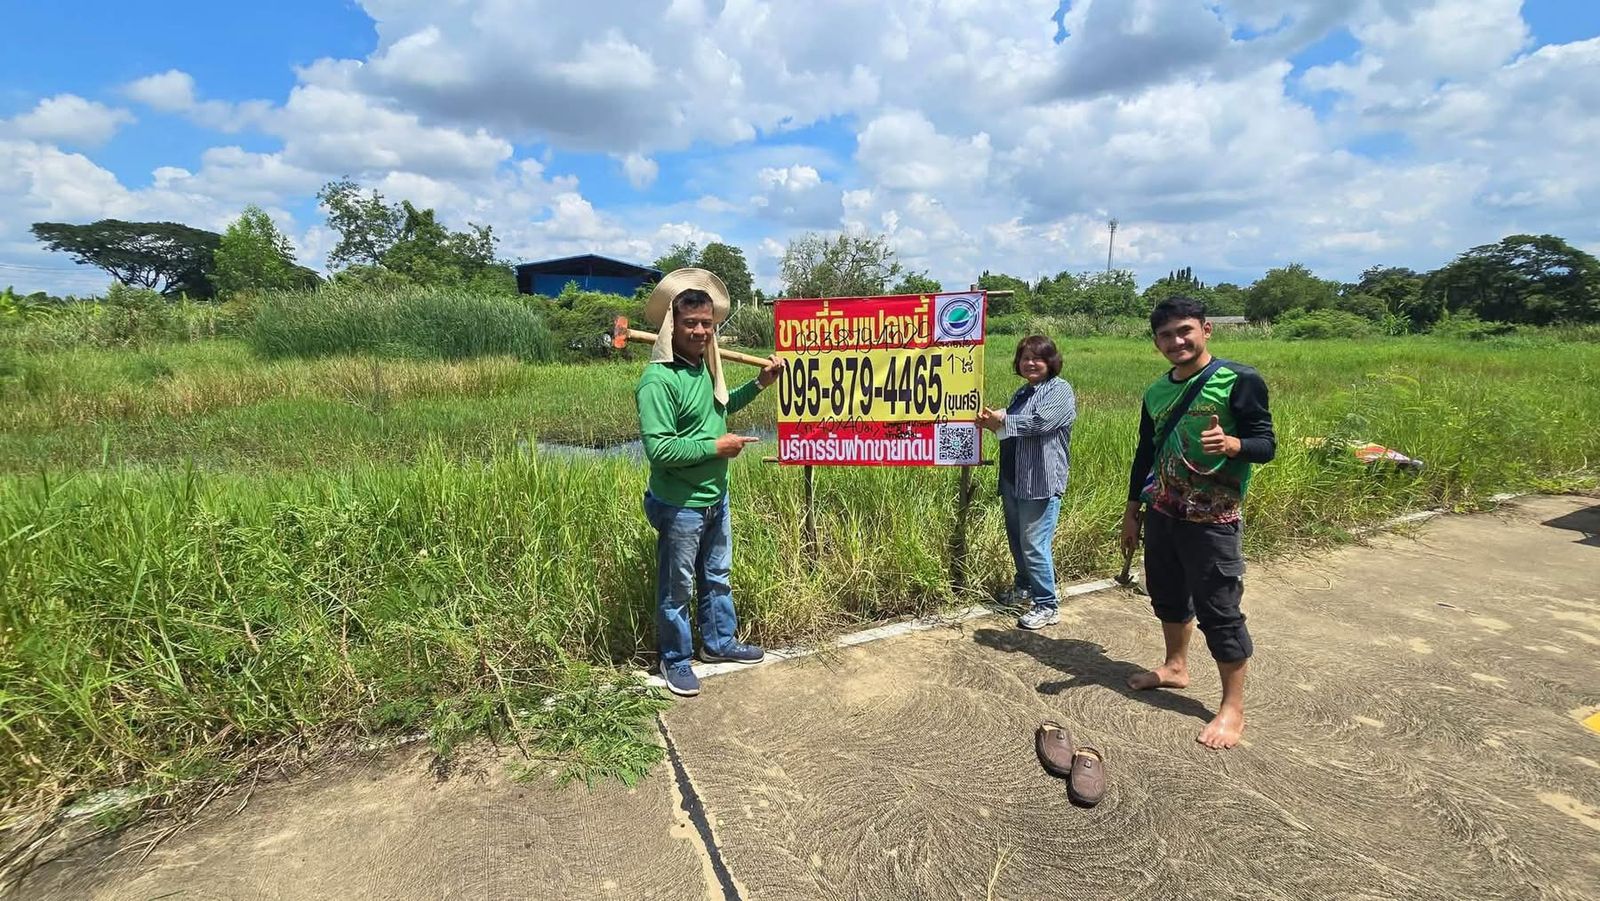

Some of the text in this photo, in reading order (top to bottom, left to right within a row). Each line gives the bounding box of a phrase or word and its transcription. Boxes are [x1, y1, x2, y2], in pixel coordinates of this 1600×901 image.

[779, 354, 981, 417] 095-879-4465 (ขุนศรี)
[780, 427, 933, 461] บริการรับฝากขายที่ดิน
